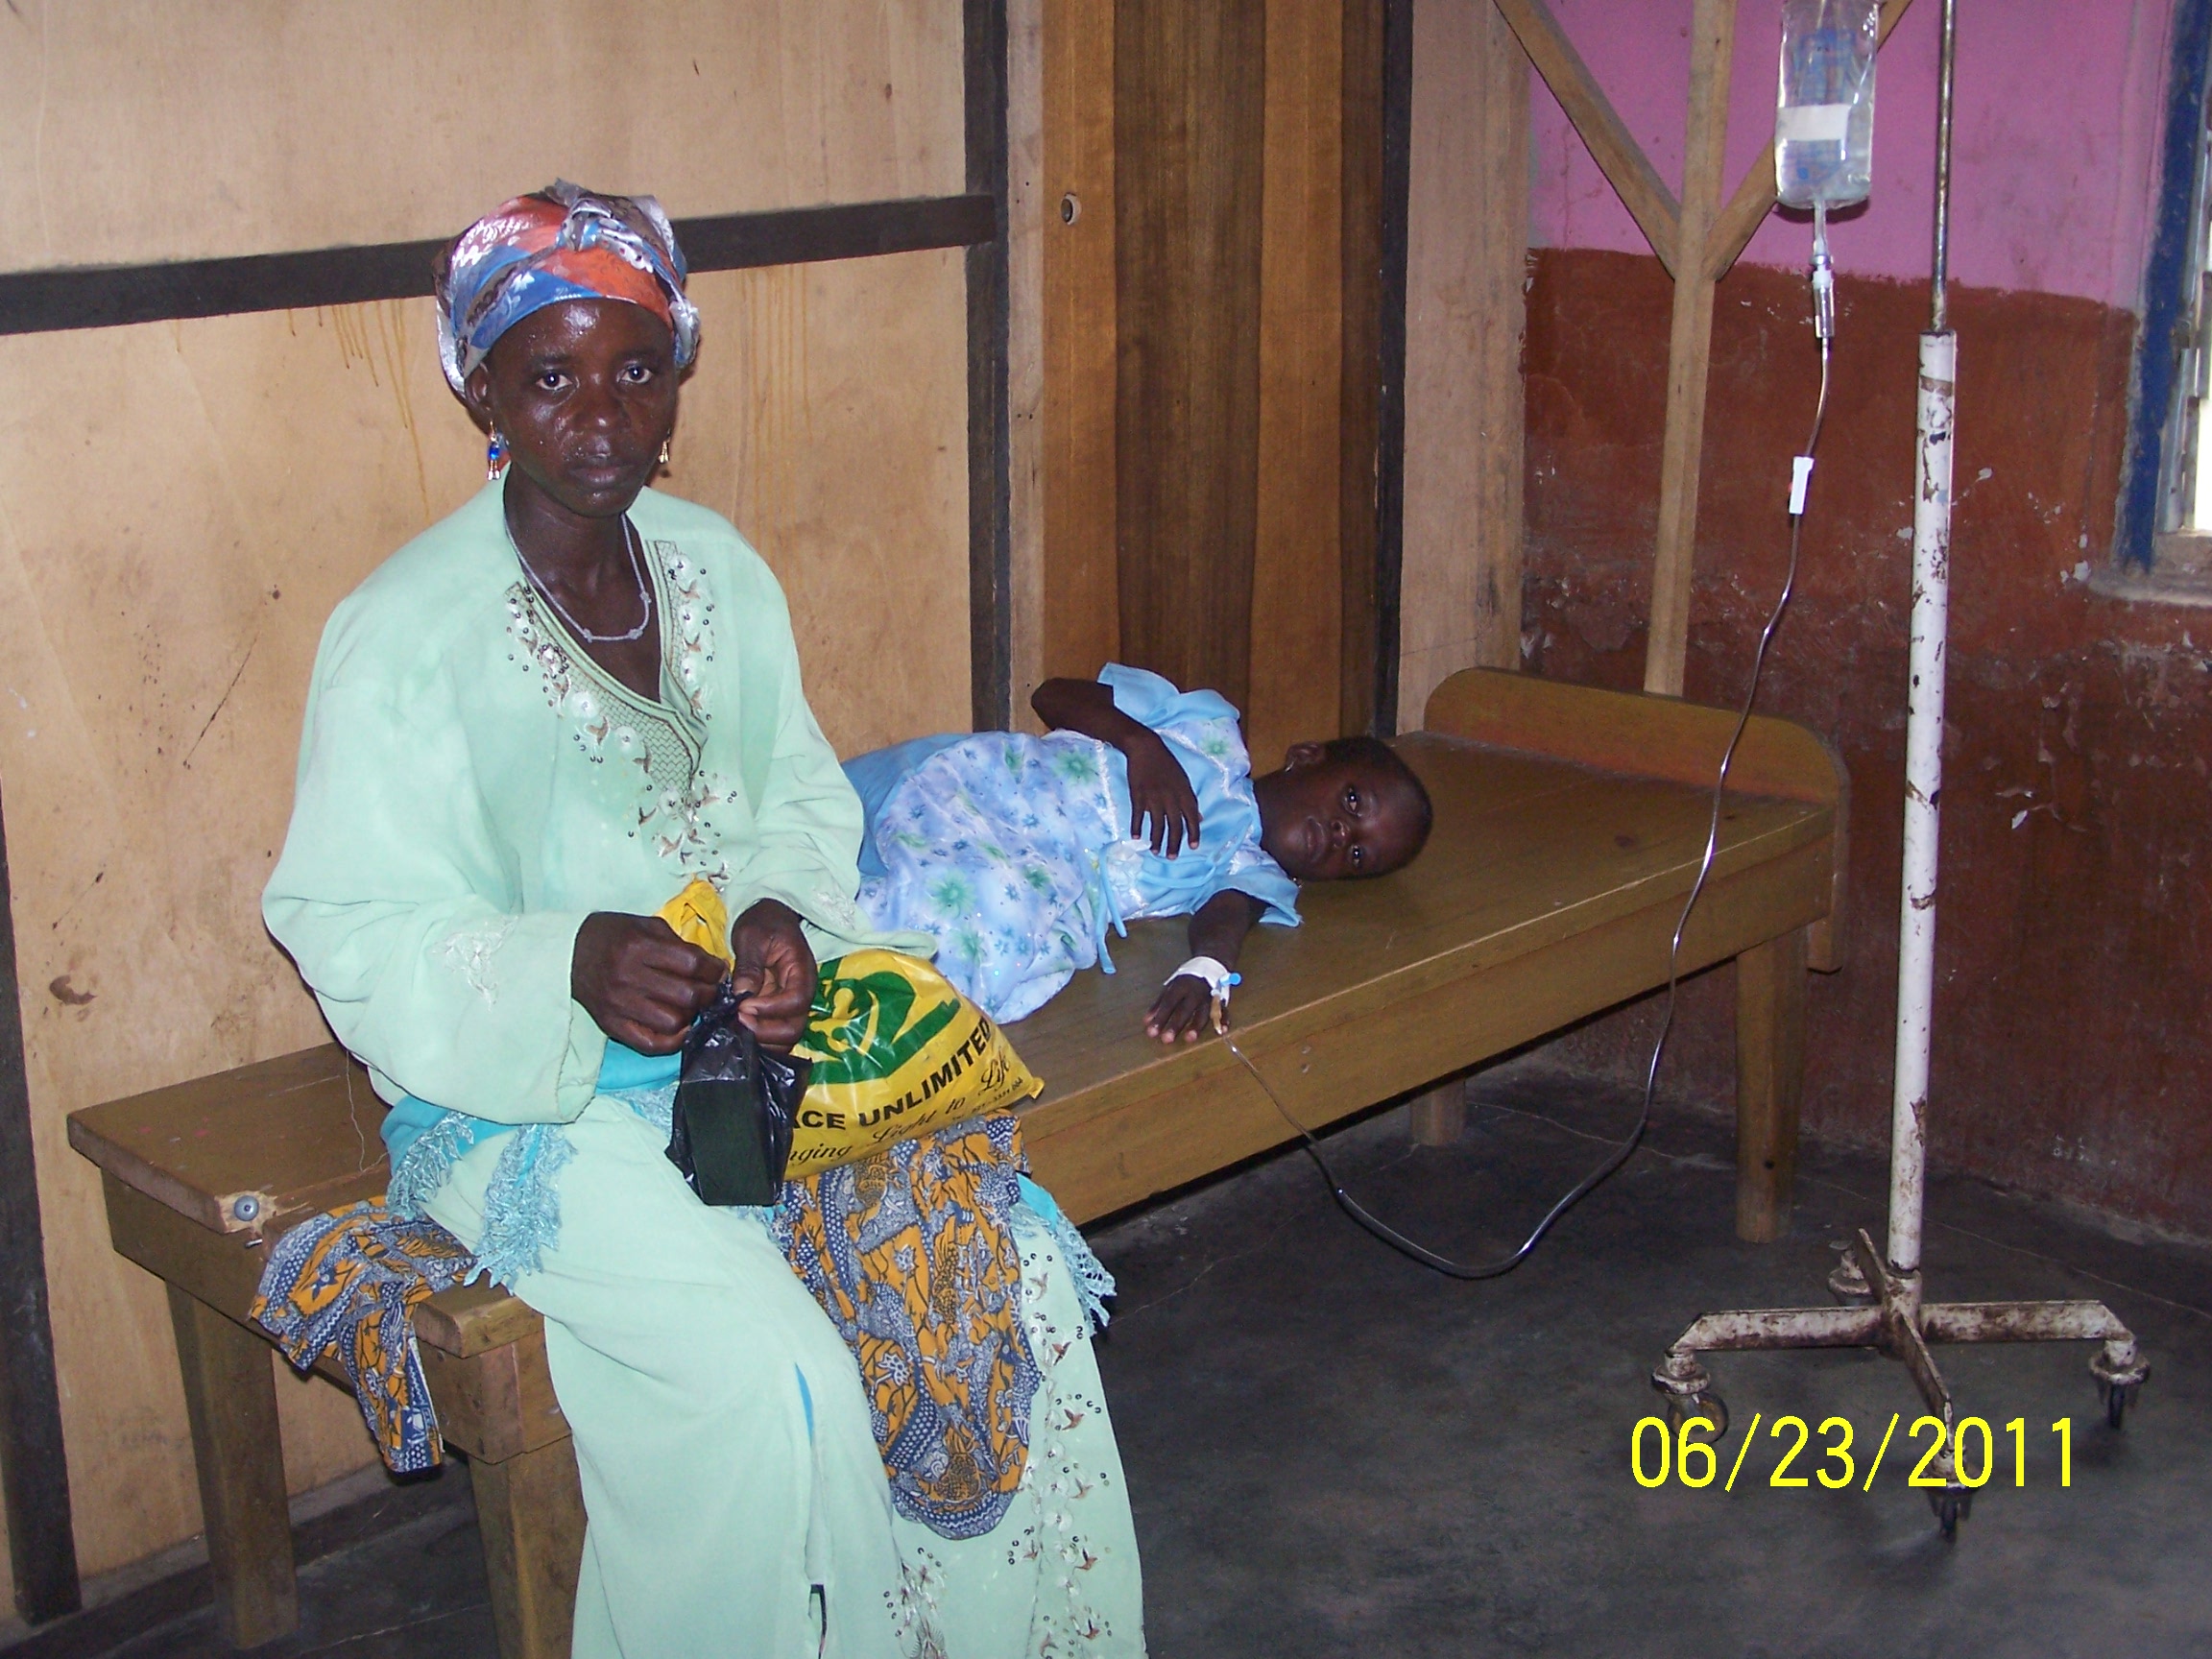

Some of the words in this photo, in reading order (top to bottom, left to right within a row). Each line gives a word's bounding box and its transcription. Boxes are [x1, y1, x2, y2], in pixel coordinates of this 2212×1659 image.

[858, 1015, 993, 1127] UNLIMITED
[866, 1110, 937, 1146] Light
[946, 1096, 966, 1115] to
